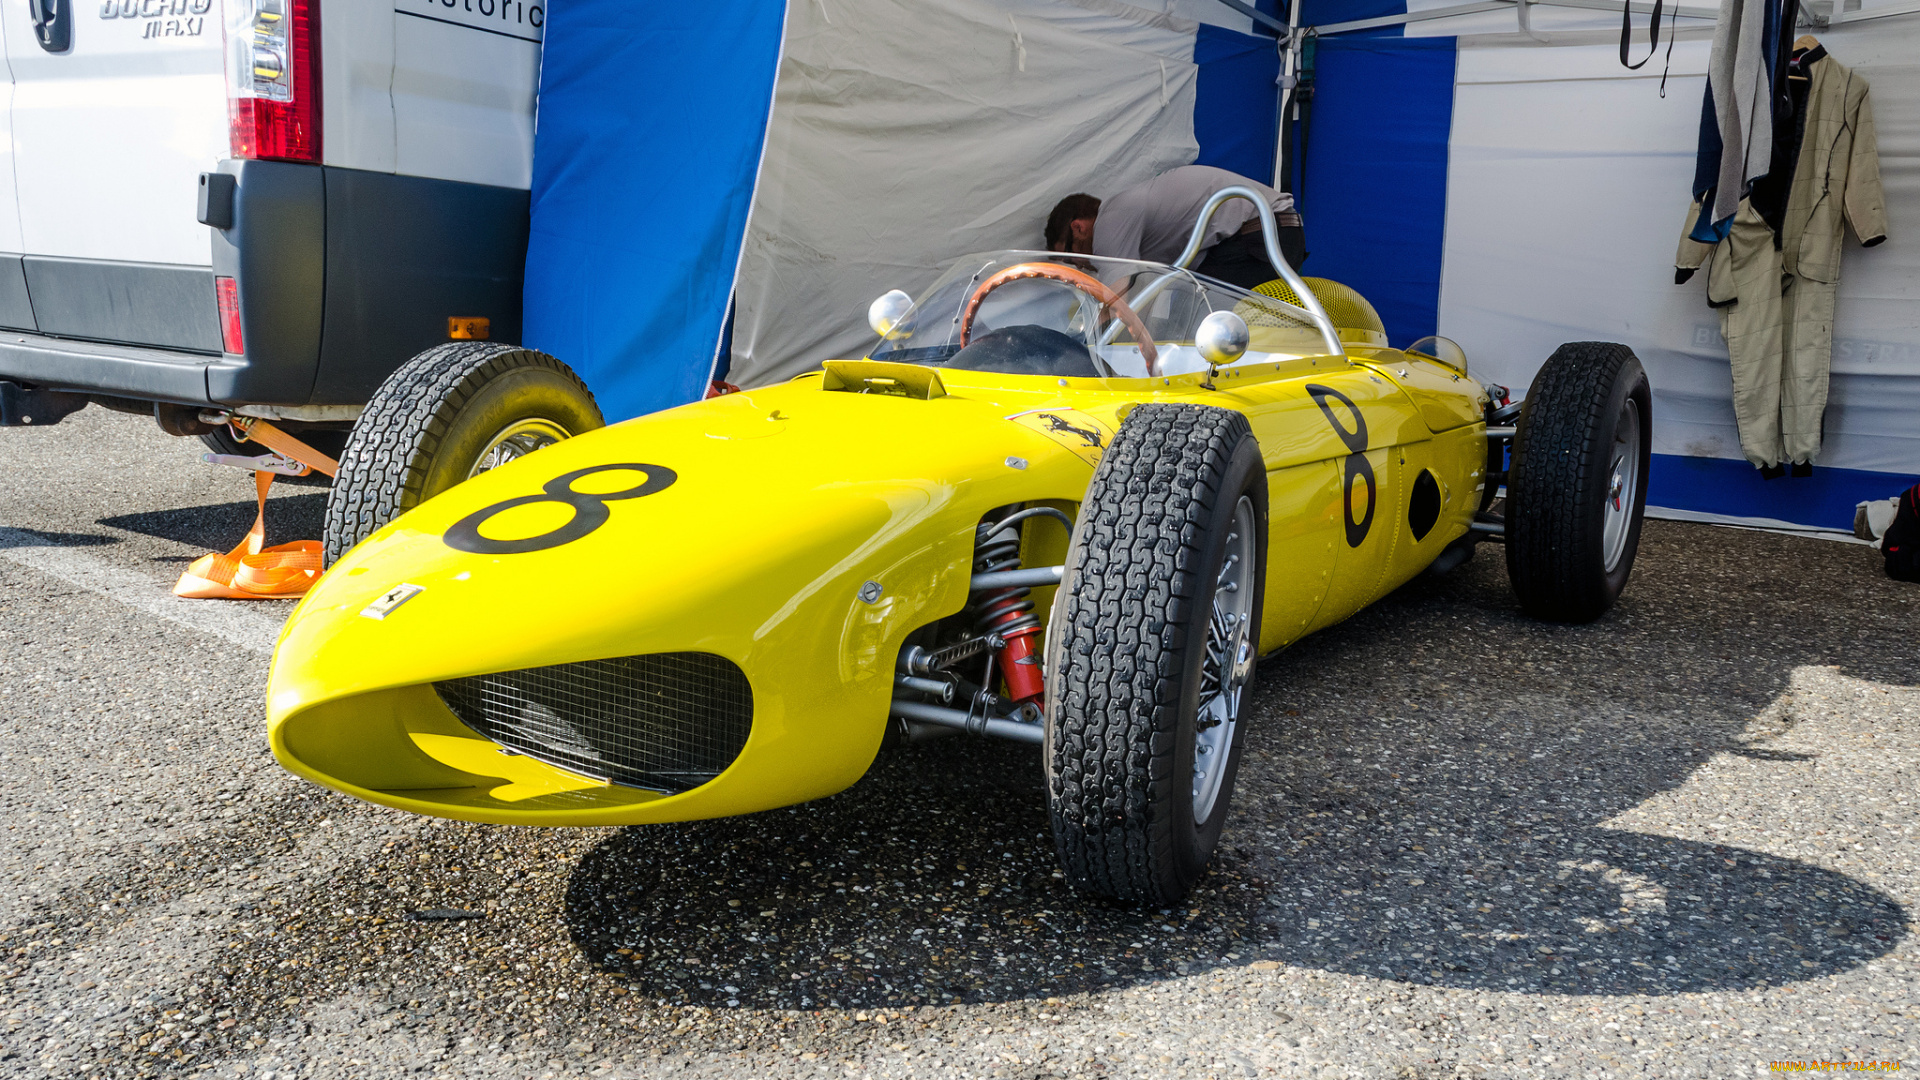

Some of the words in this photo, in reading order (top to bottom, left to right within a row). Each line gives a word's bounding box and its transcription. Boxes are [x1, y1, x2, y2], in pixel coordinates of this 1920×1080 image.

[142, 17, 204, 39] MAXI
[428, 0, 544, 28] oric
[1305, 383, 1376, 548] 8
[442, 462, 678, 555] 8
